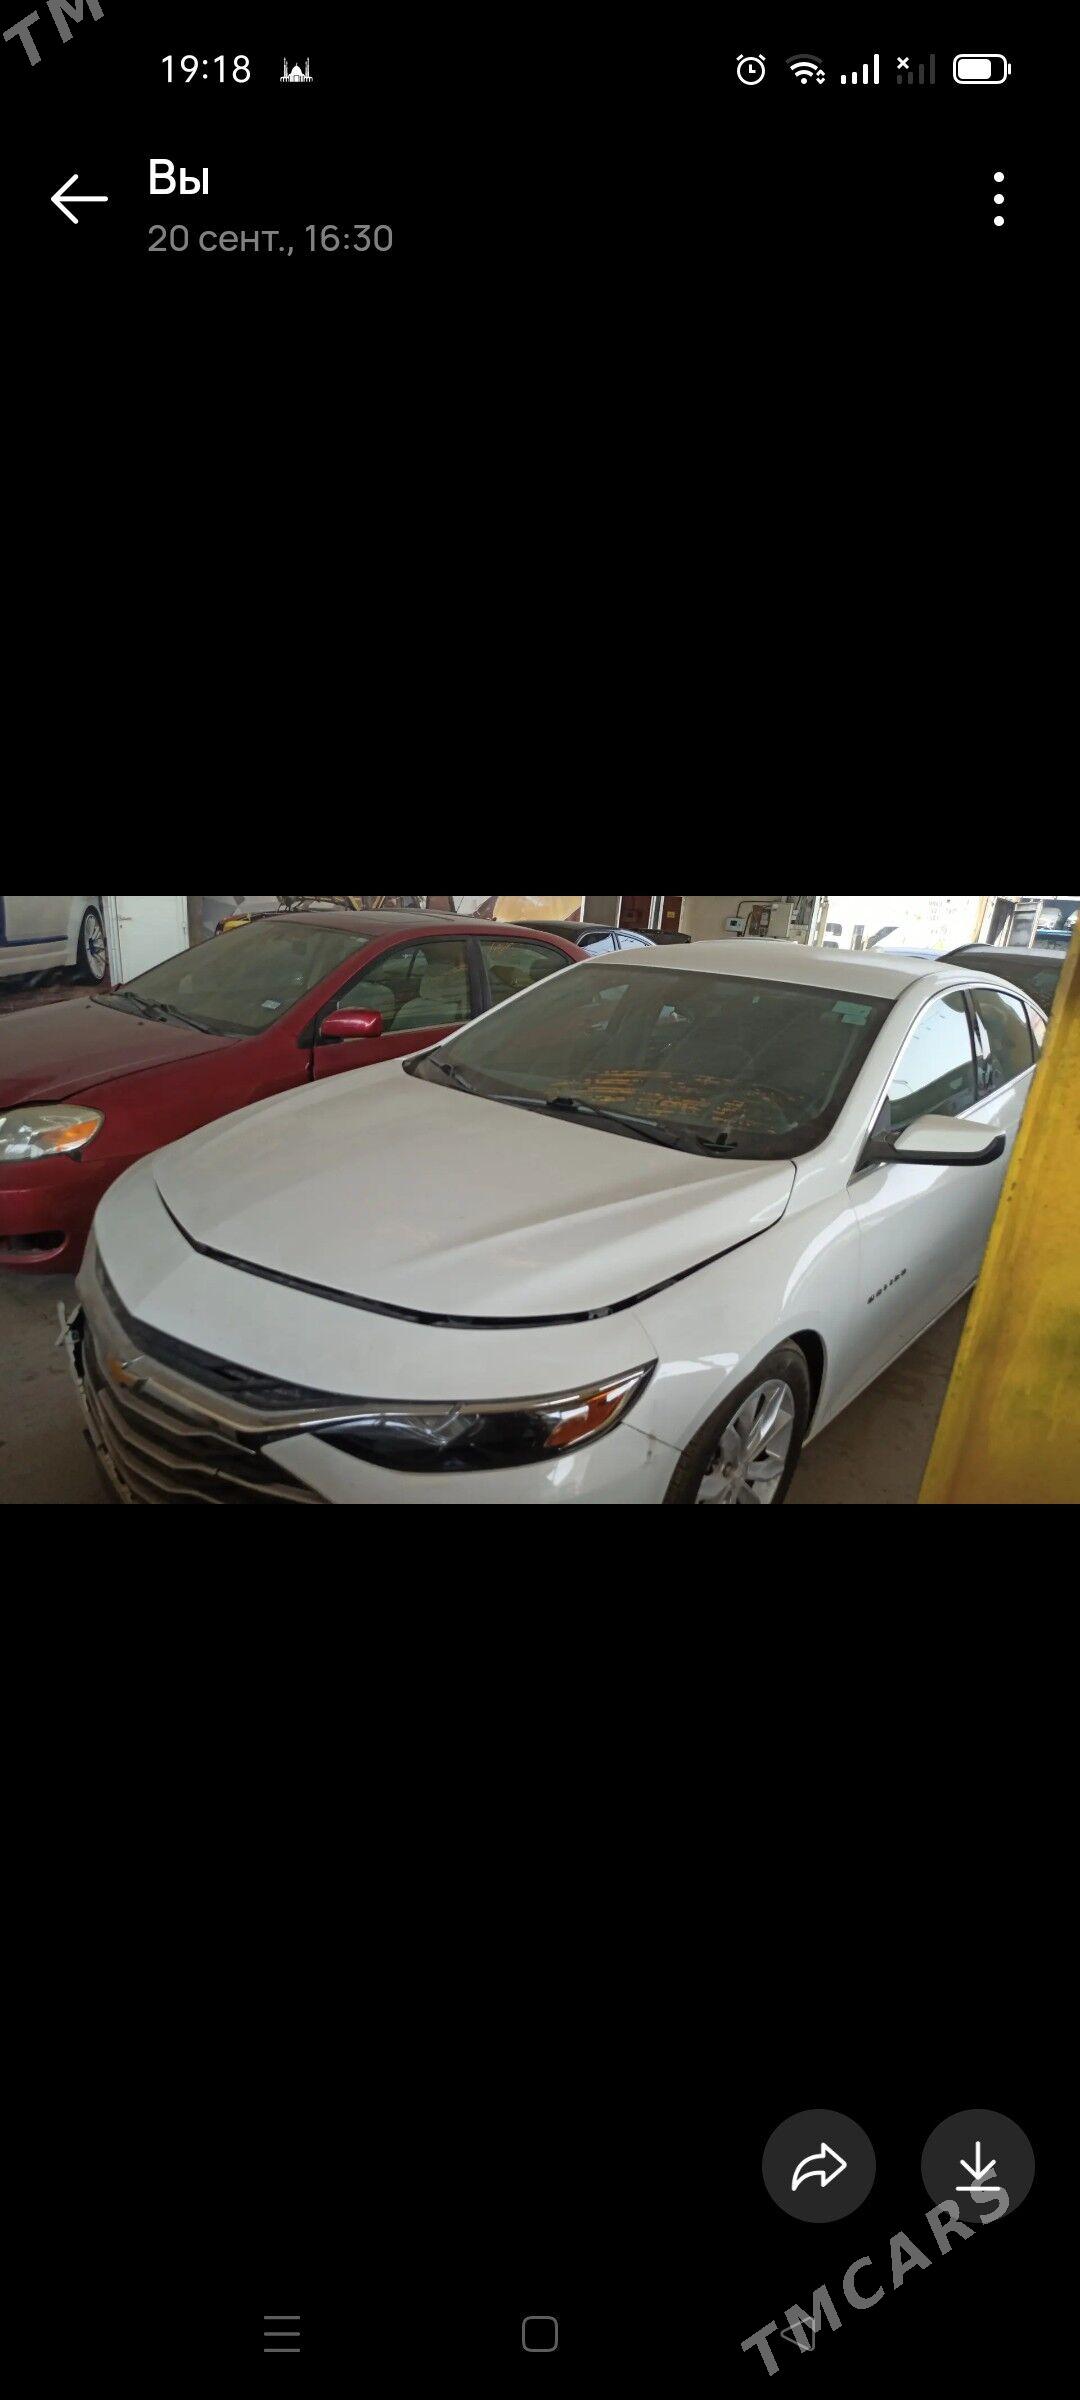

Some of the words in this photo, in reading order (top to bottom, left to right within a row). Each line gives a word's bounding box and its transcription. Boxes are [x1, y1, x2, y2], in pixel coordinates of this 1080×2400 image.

[161, 55, 250, 84] 19:18
[149, 159, 209, 194] Вы
[149, 225, 188, 251] 20
[199, 231, 293, 256] сент.,
[306, 225, 392, 251] 16:30
